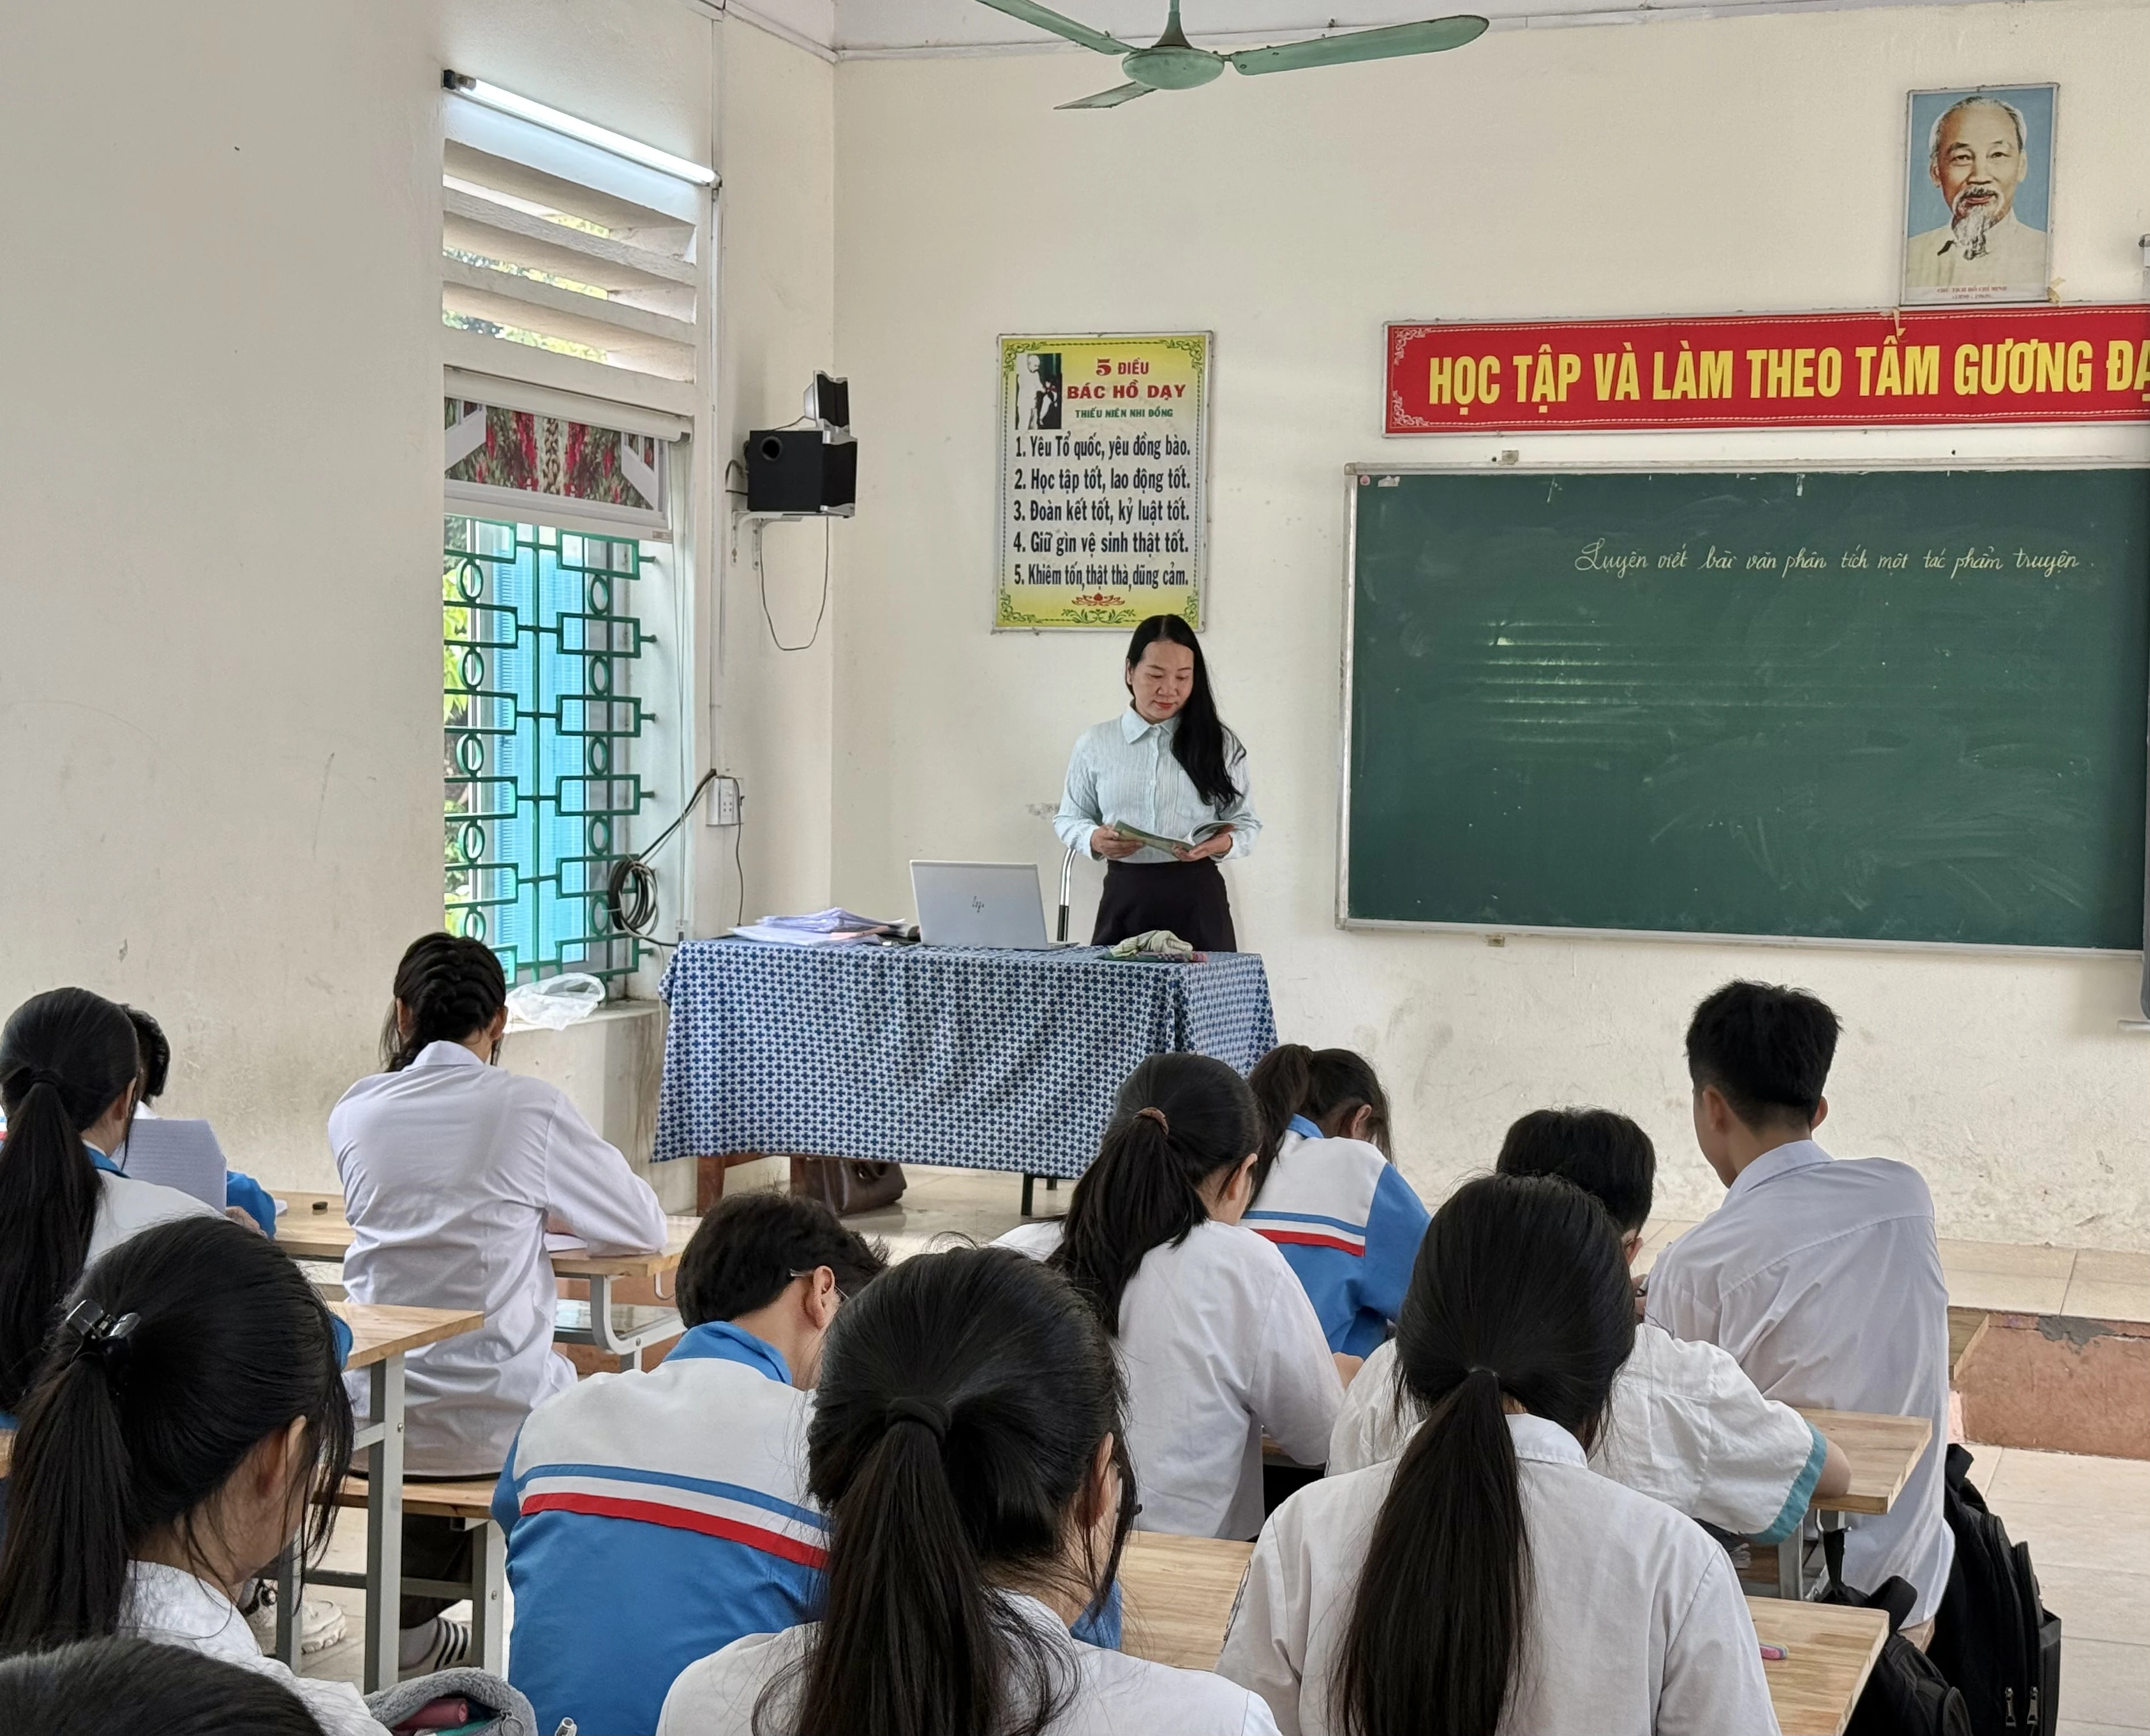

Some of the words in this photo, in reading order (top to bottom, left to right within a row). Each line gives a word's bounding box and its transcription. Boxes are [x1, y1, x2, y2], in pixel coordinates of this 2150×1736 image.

[1096, 358, 1112, 376] 5
[1118, 356, 1150, 375] ĐIỀU
[1429, 355, 1500, 415] HỌC
[1513, 344, 1581, 413] TẬP
[1594, 341, 1639, 402] VÀ
[1653, 340, 1733, 400] LÀM
[1746, 347, 1842, 399] THEO
[1855, 328, 1940, 396] TẤM
[1954, 338, 2093, 395] GƯƠNG
[1067, 382, 1106, 399] BÁC
[1113, 380, 1139, 399] HỒ
[1147, 384, 1186, 401] DẠY
[1075, 406, 1103, 418] THIẾU
[1105, 409, 1127, 418] NIÊN
[1130, 409, 1145, 418] NHI
[1016, 436, 1026, 457] 1.
[1031, 436, 1052, 457] Yêu
[1055, 431, 1072, 457] Tổ
[1074, 432, 1105, 460] quốc,
[1108, 436, 1129, 460] yêu
[1133, 432, 1161, 460] đồng
[1166, 434, 1191, 456] bào.
[1014, 469, 1026, 490] 2.
[1031, 469, 1055, 493] Học
[1059, 468, 1080, 493] tập
[1084, 466, 1106, 493] tốt,
[1111, 469, 1129, 489] lao
[1133, 469, 1163, 493] động
[1168, 465, 1191, 489] tốt.
[1013, 500, 1026, 521] 3.
[1030, 500, 1062, 521] Đoàn
[1066, 497, 1087, 521] kết
[1092, 497, 1114, 525] tốt,
[1118, 497, 1133, 525] kỷ
[1139, 500, 1163, 526] luật
[1167, 497, 1189, 521] tốt.
[1013, 531, 1026, 553] 4.
[1031, 531, 1054, 553] Giữ
[1056, 531, 1077, 556] gìn
[1081, 532, 1096, 557] vệ
[1101, 531, 1128, 553] sinh
[1133, 531, 1160, 557] thật
[1165, 529, 1188, 552] tốt.
[1014, 564, 1025, 585] 5.
[1028, 563, 1061, 585] Khiêm
[1163, 562, 1189, 586] cảm.
[1781, 547, 1827, 578] phân
